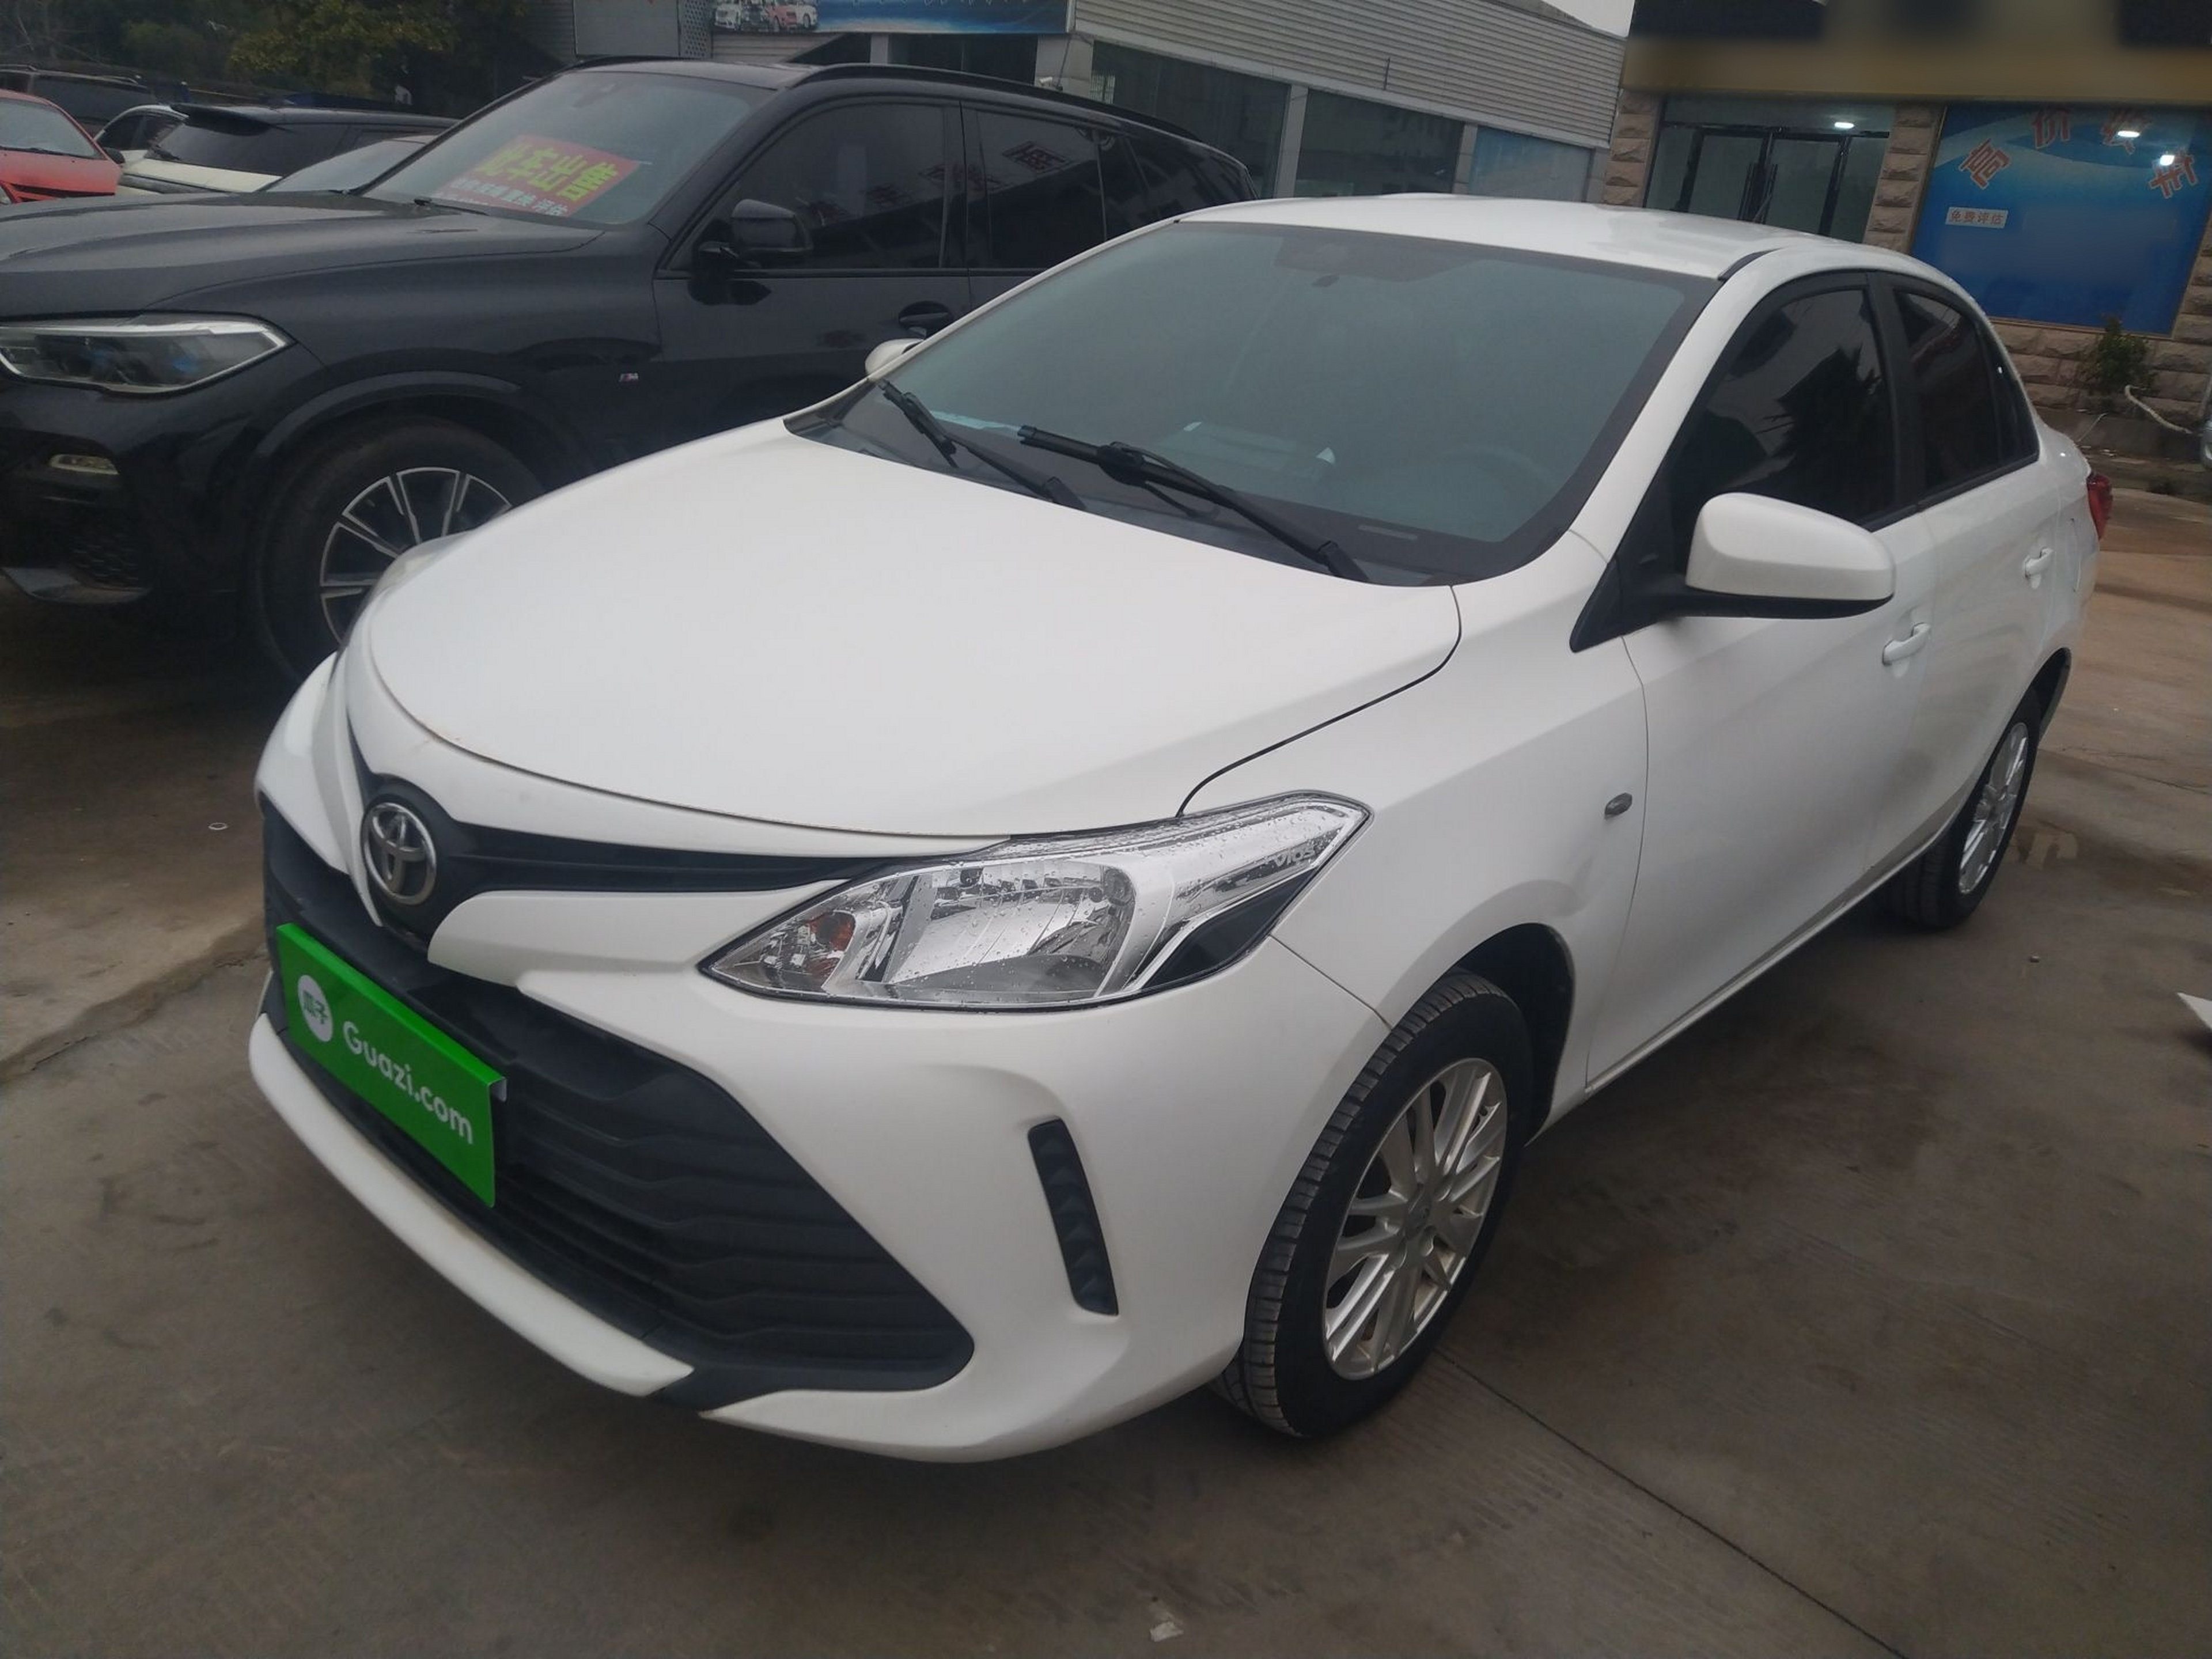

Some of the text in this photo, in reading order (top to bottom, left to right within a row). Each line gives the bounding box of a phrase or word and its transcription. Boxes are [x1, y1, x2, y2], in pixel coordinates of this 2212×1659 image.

[1950, 210, 2004, 225] 免费评估
[342, 1020, 474, 1145] Guazi.com
